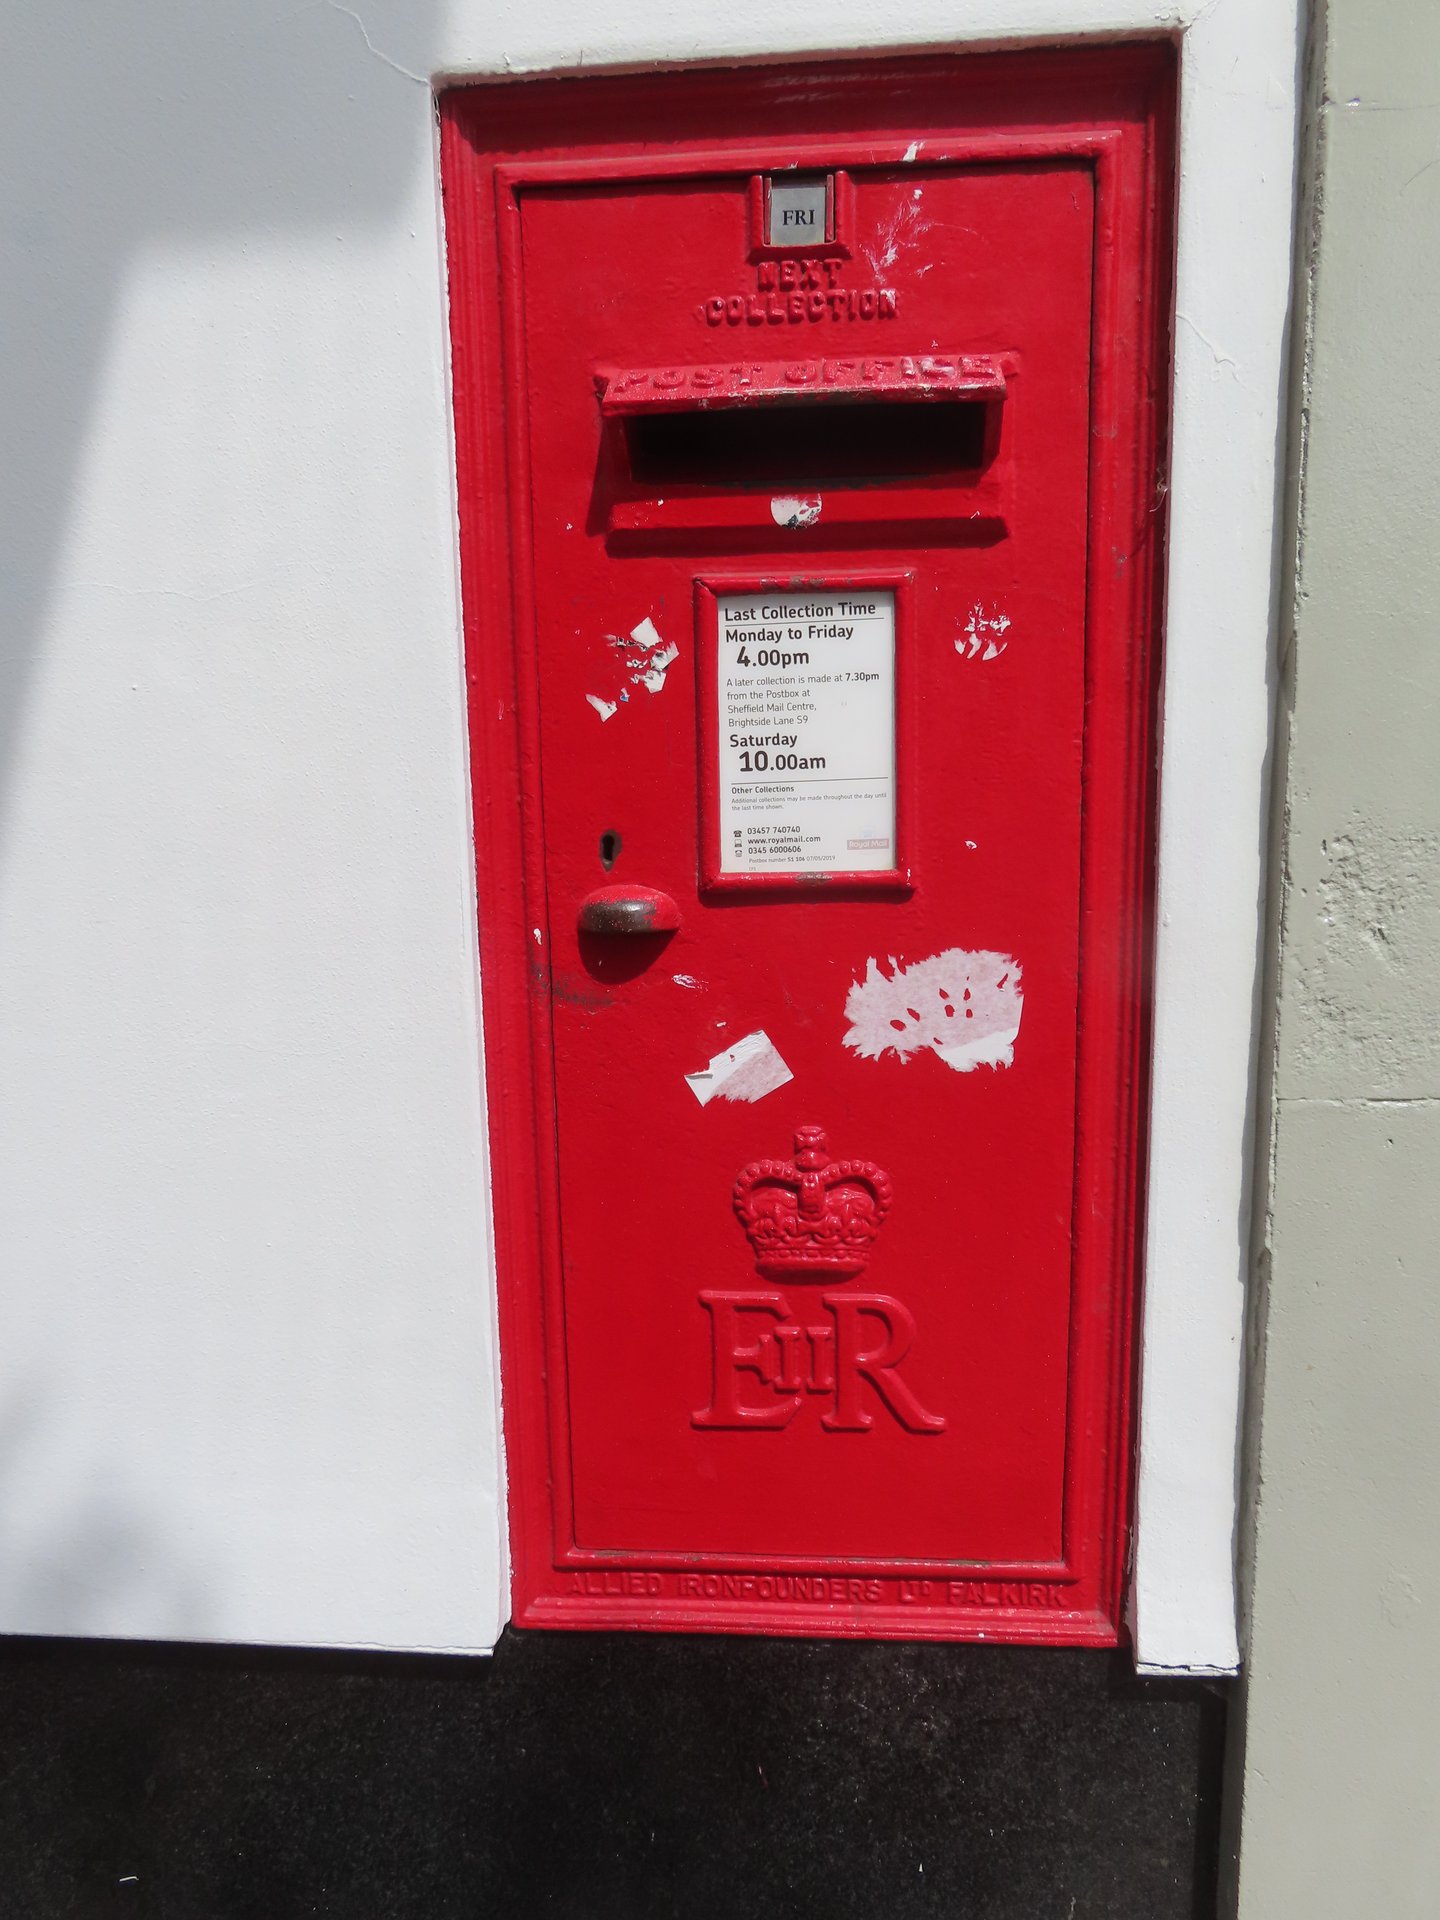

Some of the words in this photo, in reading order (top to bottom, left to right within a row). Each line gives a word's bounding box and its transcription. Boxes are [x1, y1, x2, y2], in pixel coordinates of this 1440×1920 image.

[782, 209, 815, 226] FRI
[758, 258, 842, 292] NEXT
[706, 288, 897, 327] COLLECTION
[615, 363, 763, 393] POST
[784, 355, 997, 385] OFFICE
[724, 606, 756, 621] Last
[761, 604, 834, 620] Collection
[838, 602, 876, 616] Time
[725, 628, 783, 643] Monday
[788, 626, 802, 640] to
[808, 624, 854, 640] Friday
[736, 646, 810, 669] 4.00pm
[726, 678, 733, 687] A
[734, 677, 753, 687] later
[756, 676, 796, 686] collection
[798, 675, 805, 684] is
[808, 674, 832, 683] made
[834, 674, 843, 682] at
[845, 672, 880, 683] 7.30pm
[727, 691, 747, 700] from
[750, 690, 764, 699] the
[766, 689, 800, 699] Postbox
[802, 689, 811, 697] at
[727, 703, 764, 714] Sheffield
[767, 702, 785, 712] Mail
[787, 701, 817, 712] Centre,
[728, 716, 771, 729] Brightside
[773, 715, 794, 726] Lane
[797, 714, 809, 725] S9
[729, 732, 798, 748] Saturday
[738, 750, 826, 772] 10.00am
[731, 786, 753, 794] Other
[755, 785, 795, 794] Collections
[864, 792, 873, 800] day
[747, 826, 770, 835] 03457
[772, 825, 801, 834] 740740
[747, 835, 821, 845] www.royalmail.com
[849, 840, 870, 849] Royal
[748, 846, 767, 854] 0345
[769, 845, 802, 854] 6000606
[566, 1572, 662, 1597] ALLIED
[677, 1573, 884, 1603] IRONFOUNDERS
[899, 1579, 934, 1605] LTD
[948, 1580, 1067, 1608] FALKIRK
